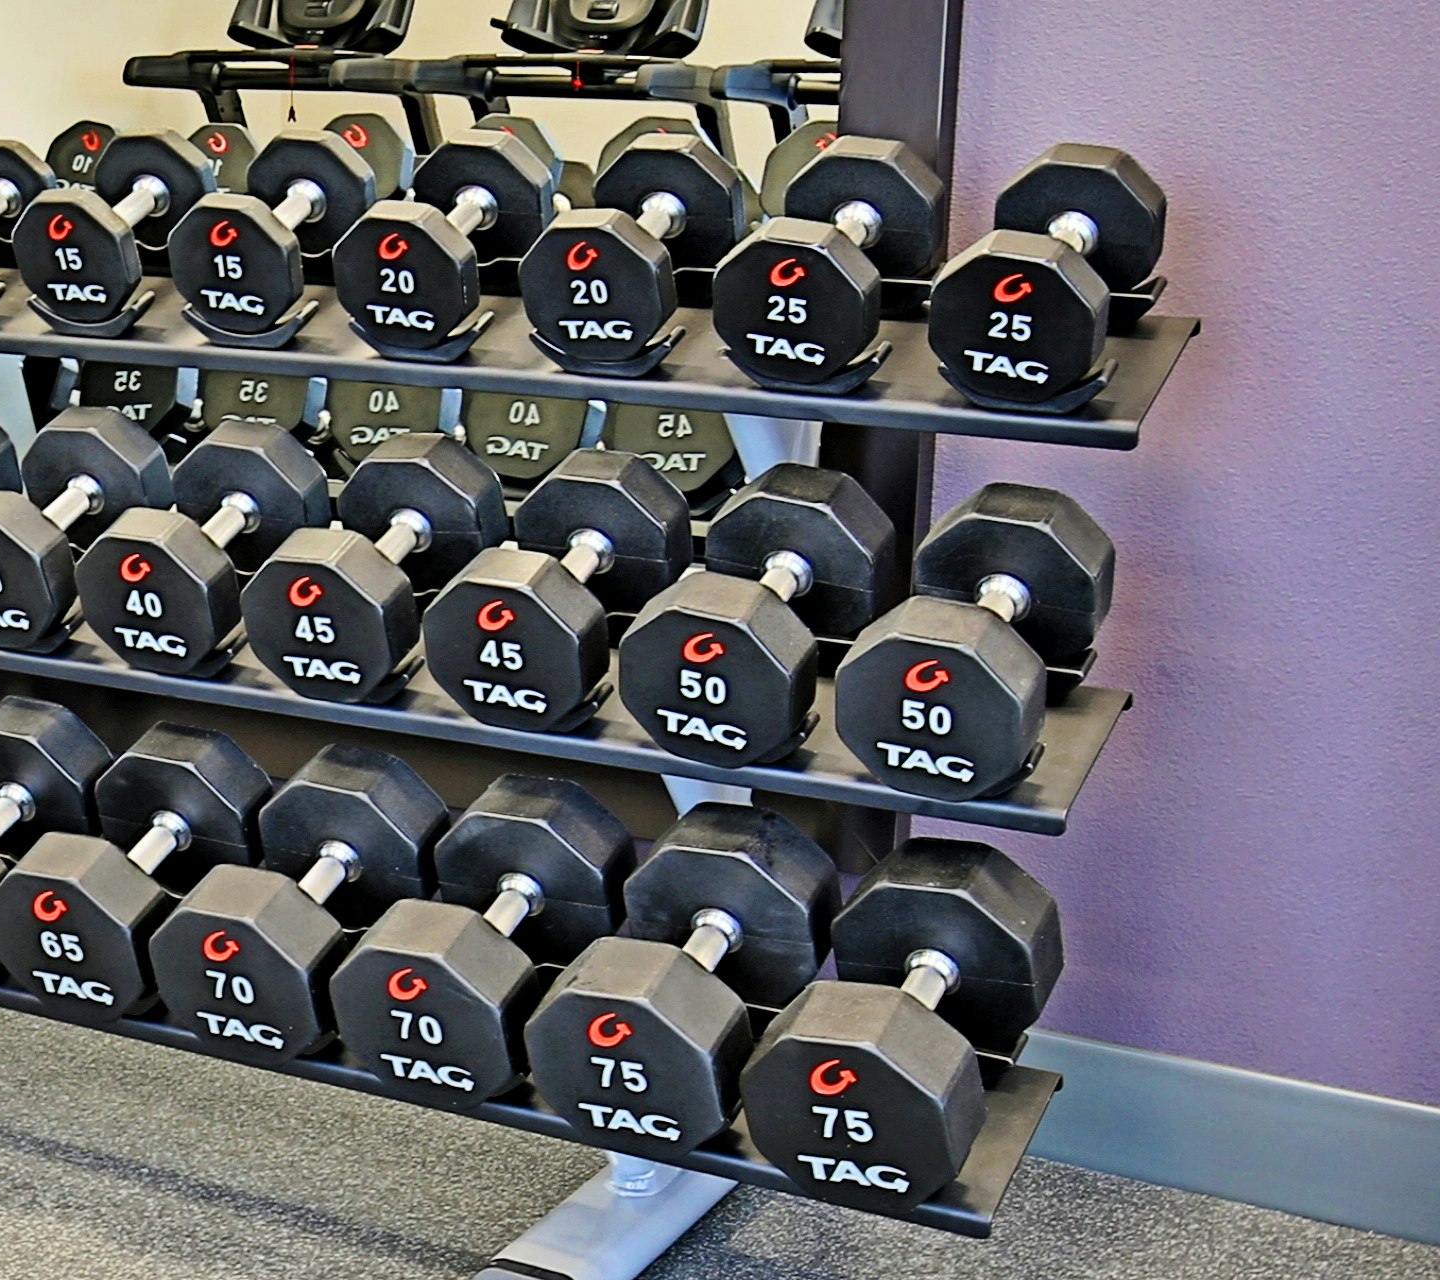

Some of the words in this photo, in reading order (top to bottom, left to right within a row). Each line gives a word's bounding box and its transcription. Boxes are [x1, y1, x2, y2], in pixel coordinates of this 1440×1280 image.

[54, 247, 83, 271] 15
[213, 254, 243, 280] 15
[47, 283, 107, 303] TAG
[380, 268, 415, 294] 20
[570, 279, 608, 305] 20
[200, 289, 265, 316] TAG
[366, 304, 435, 331] TAG
[766, 295, 807, 324] 25
[558, 320, 633, 341] TAG
[987, 311, 1032, 342] 25
[746, 333, 825, 366] TAG
[963, 349, 1049, 384] TAG
[126, 589, 162, 618] 40
[113, 626, 187, 658] TAG
[295, 615, 335, 644] 45
[282, 655, 361, 684] TAG
[479, 639, 523, 671] 45
[463, 679, 547, 714] TAG
[680, 669, 726, 705] 50
[654, 708, 747, 751] TAG
[902, 699, 952, 735] 50
[876, 741, 975, 783] TAG
[40, 931, 84, 962] 65
[32, 970, 114, 1006] TAG
[205, 969, 254, 1004] 70
[196, 1011, 284, 1050] TAG
[390, 1009, 443, 1045] 70
[380, 1053, 475, 1092] TAG
[590, 1056, 648, 1093] 75
[578, 1102, 681, 1141] TAG
[811, 1105, 874, 1143] 75
[797, 1154, 910, 1193] TAG
